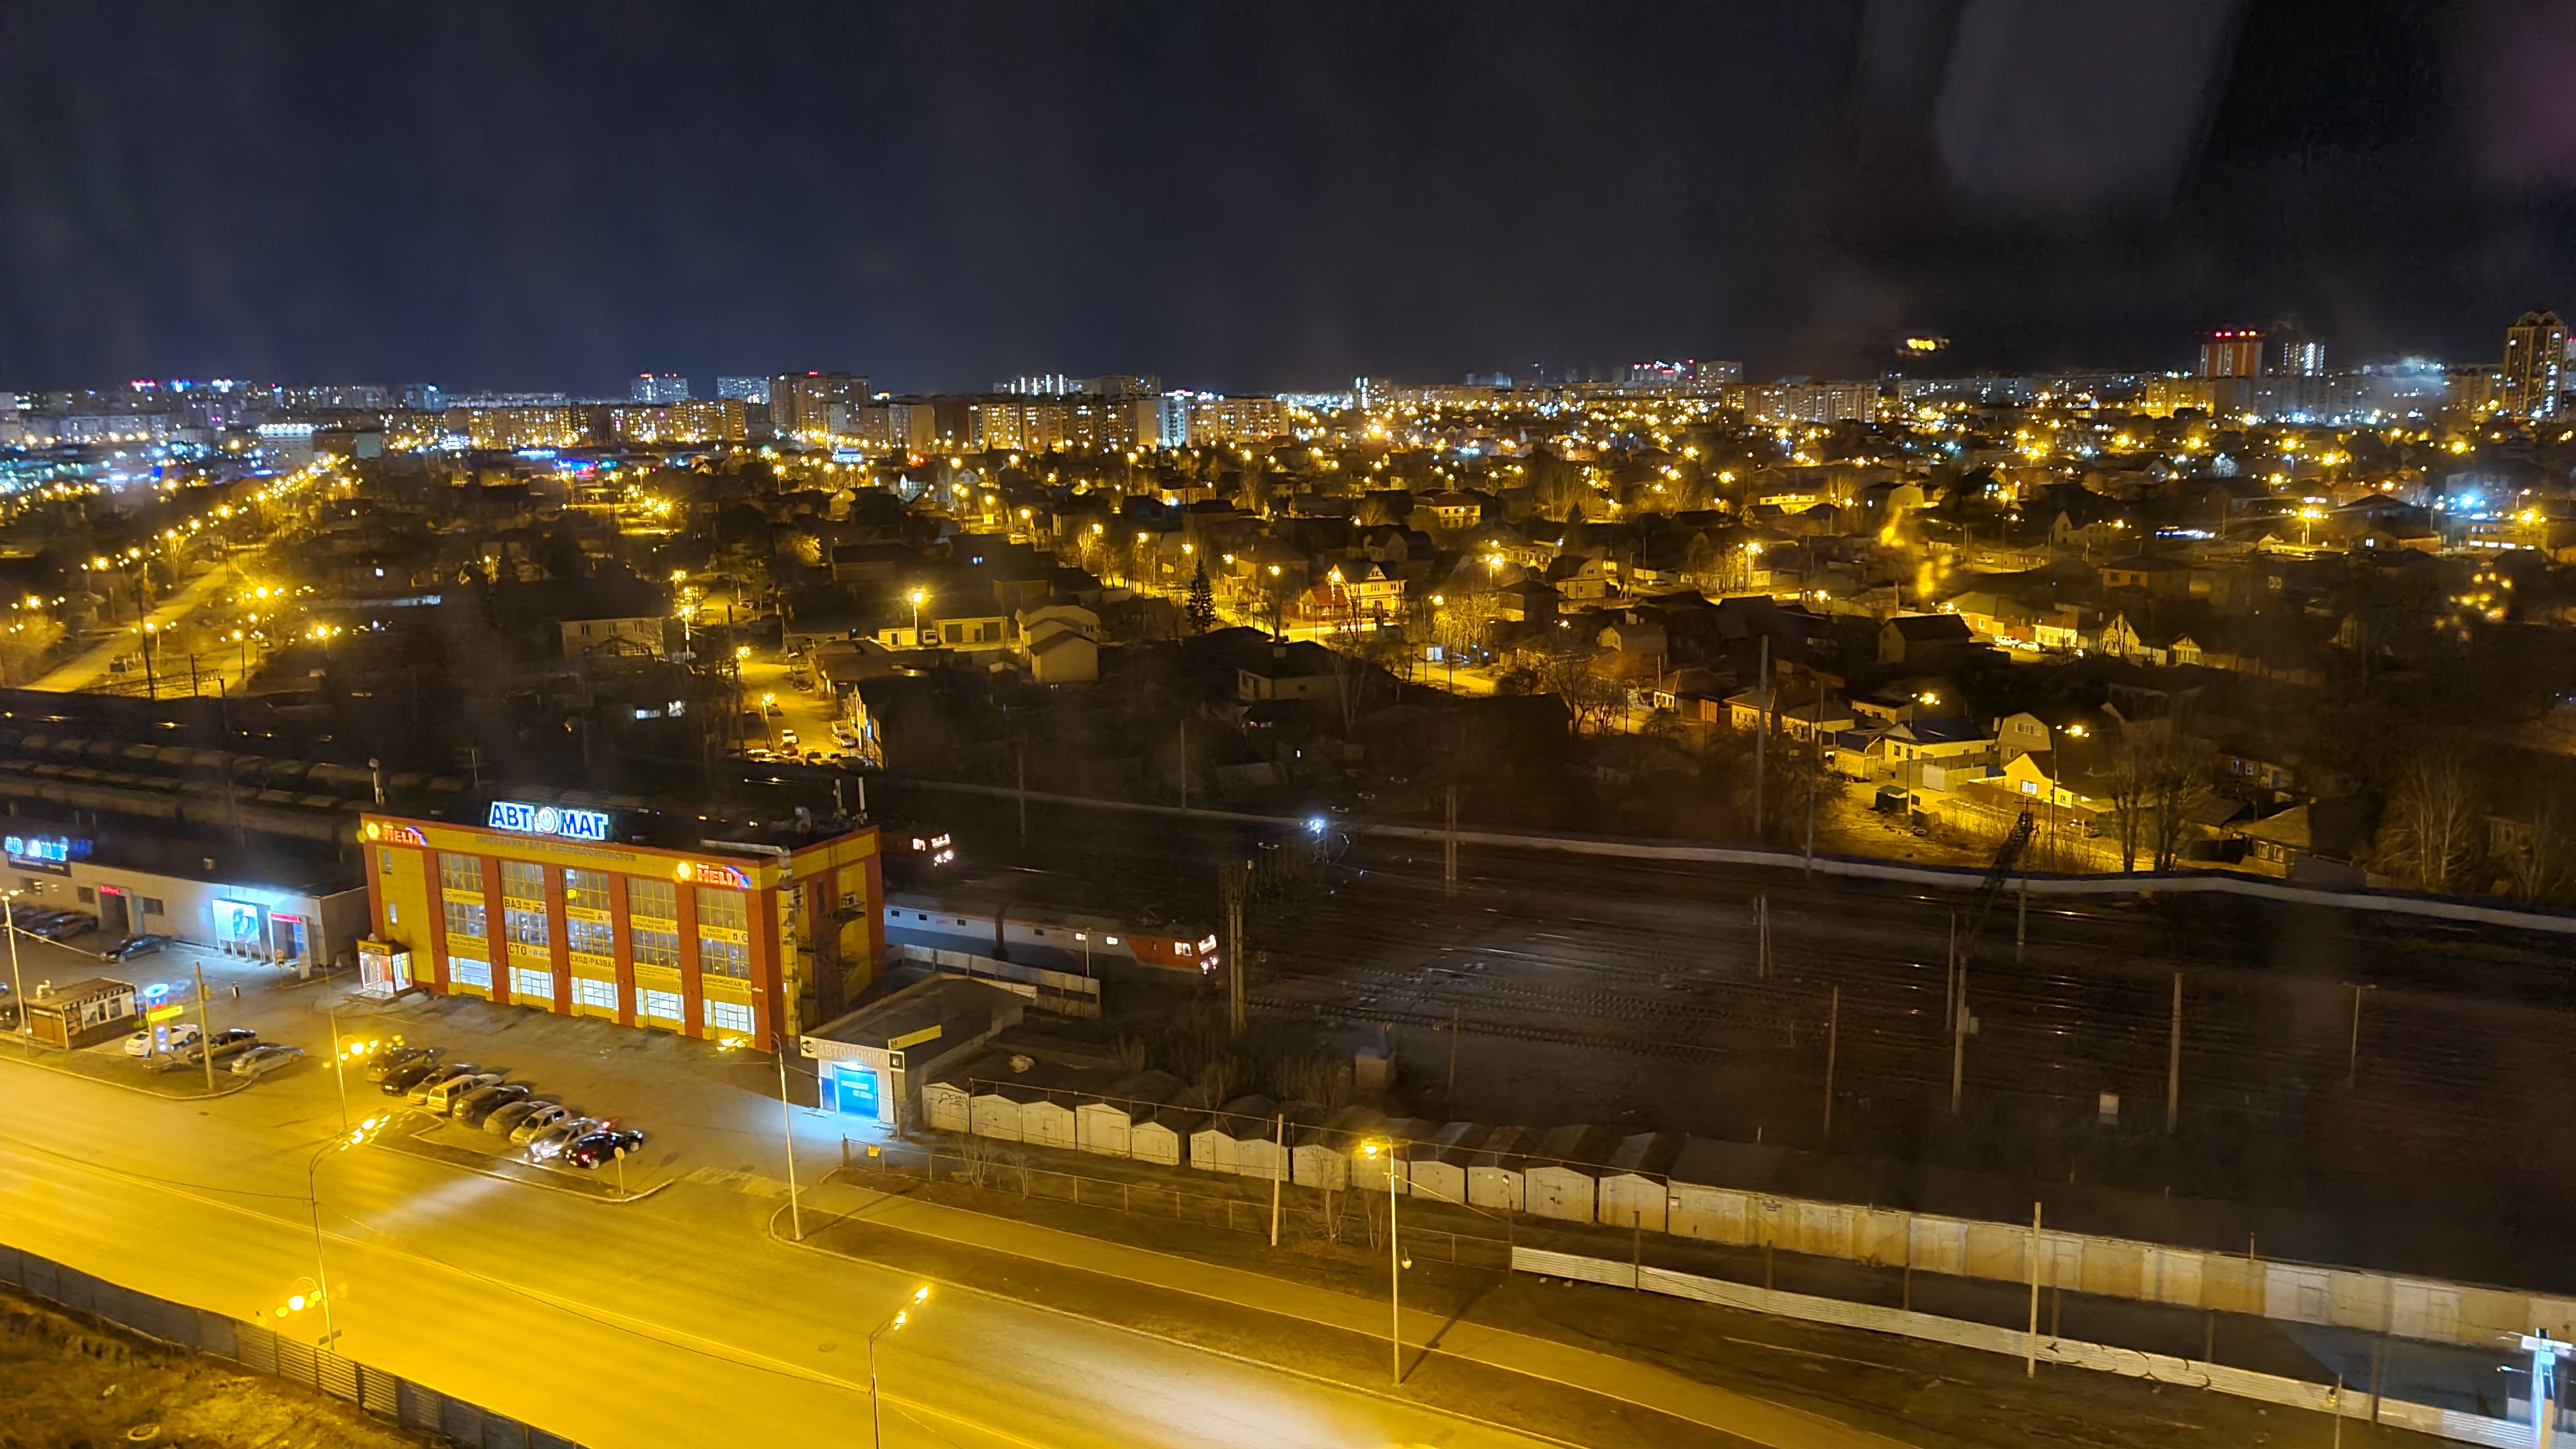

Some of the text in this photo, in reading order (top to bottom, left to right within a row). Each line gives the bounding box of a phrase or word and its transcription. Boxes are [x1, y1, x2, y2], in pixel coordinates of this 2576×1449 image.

[505, 899, 521, 909] ВАЗ
[509, 944, 526, 955] СТО
[703, 976, 742, 986] ШИНОМОНТАЖ
